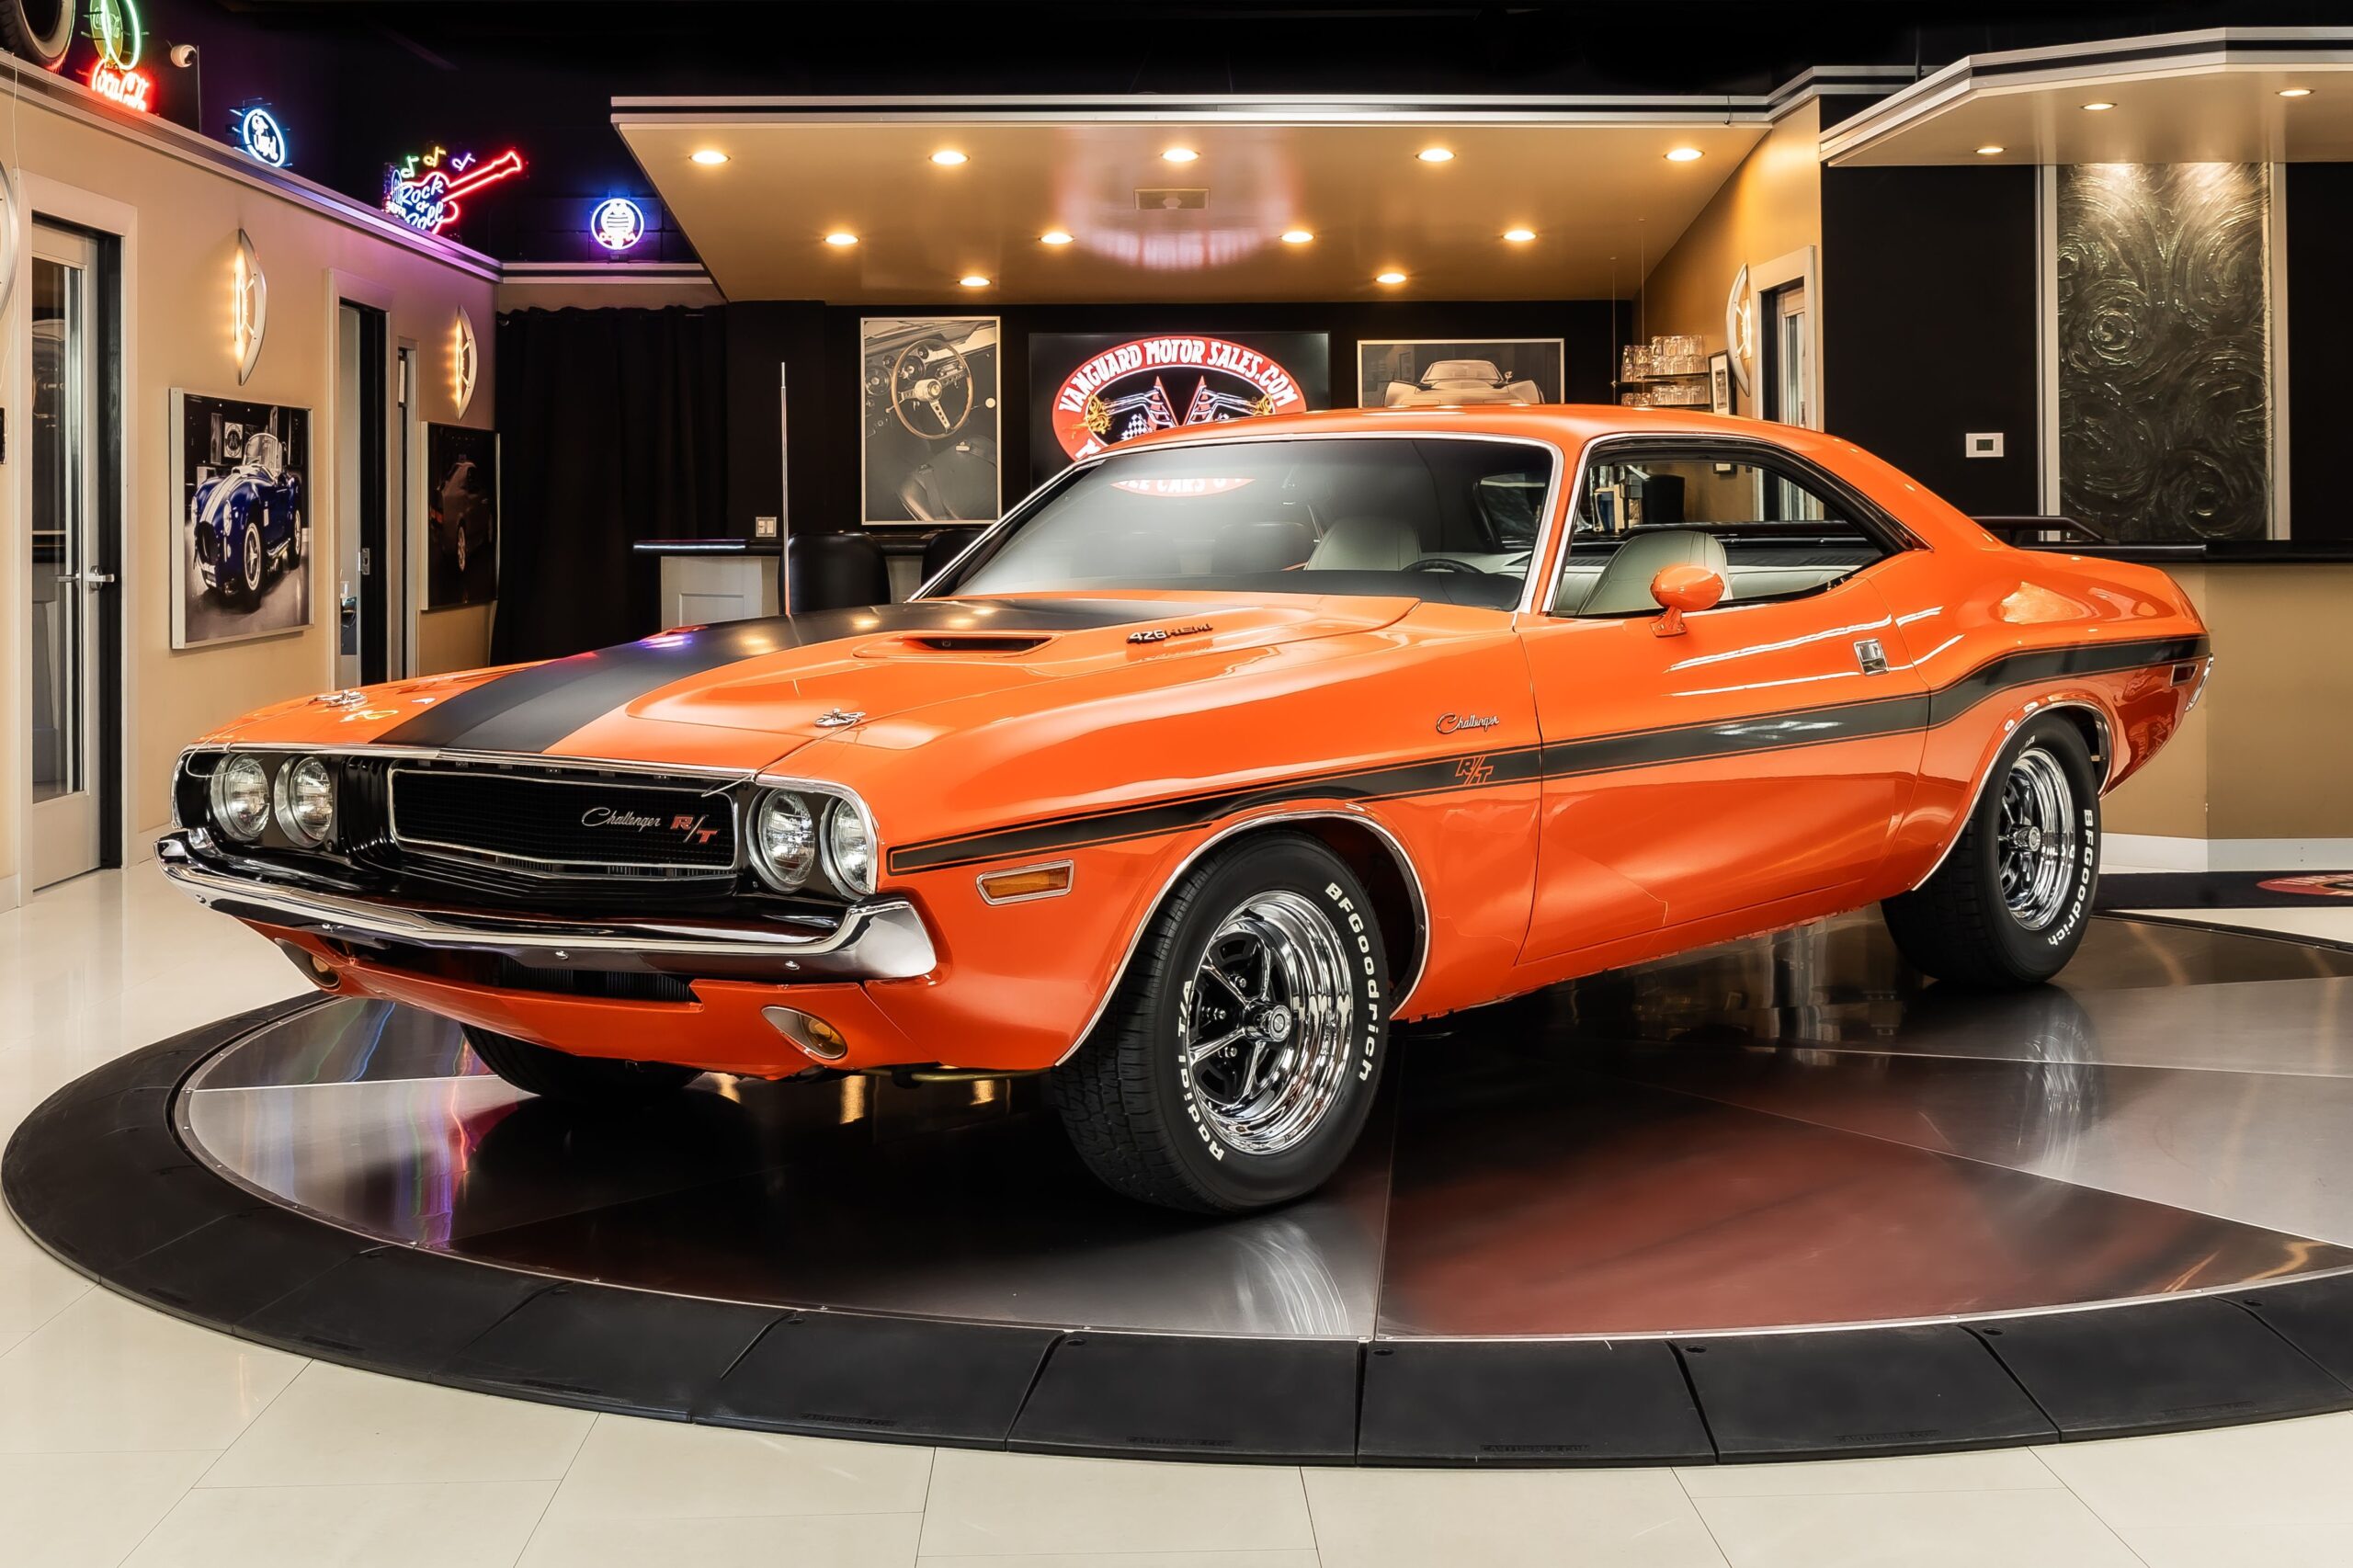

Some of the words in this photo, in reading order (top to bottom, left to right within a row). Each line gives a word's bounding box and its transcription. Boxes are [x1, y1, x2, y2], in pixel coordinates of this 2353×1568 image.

[394, 175, 444, 206] Rock
[1059, 345, 1142, 413] VANGUARD
[1143, 339, 1205, 365] MOTOR
[1207, 341, 1298, 407] SALES.COM
[1127, 630, 1167, 643] 426
[1437, 712, 1500, 734] Challenger
[1455, 756, 1494, 786] R/T
[582, 807, 661, 832] Challenger
[669, 813, 720, 844] R/T
[2048, 810, 2094, 946] BFGoodrich
[1325, 882, 1380, 1081] BFGoodrich
[1178, 1055, 1224, 1161] Radial
